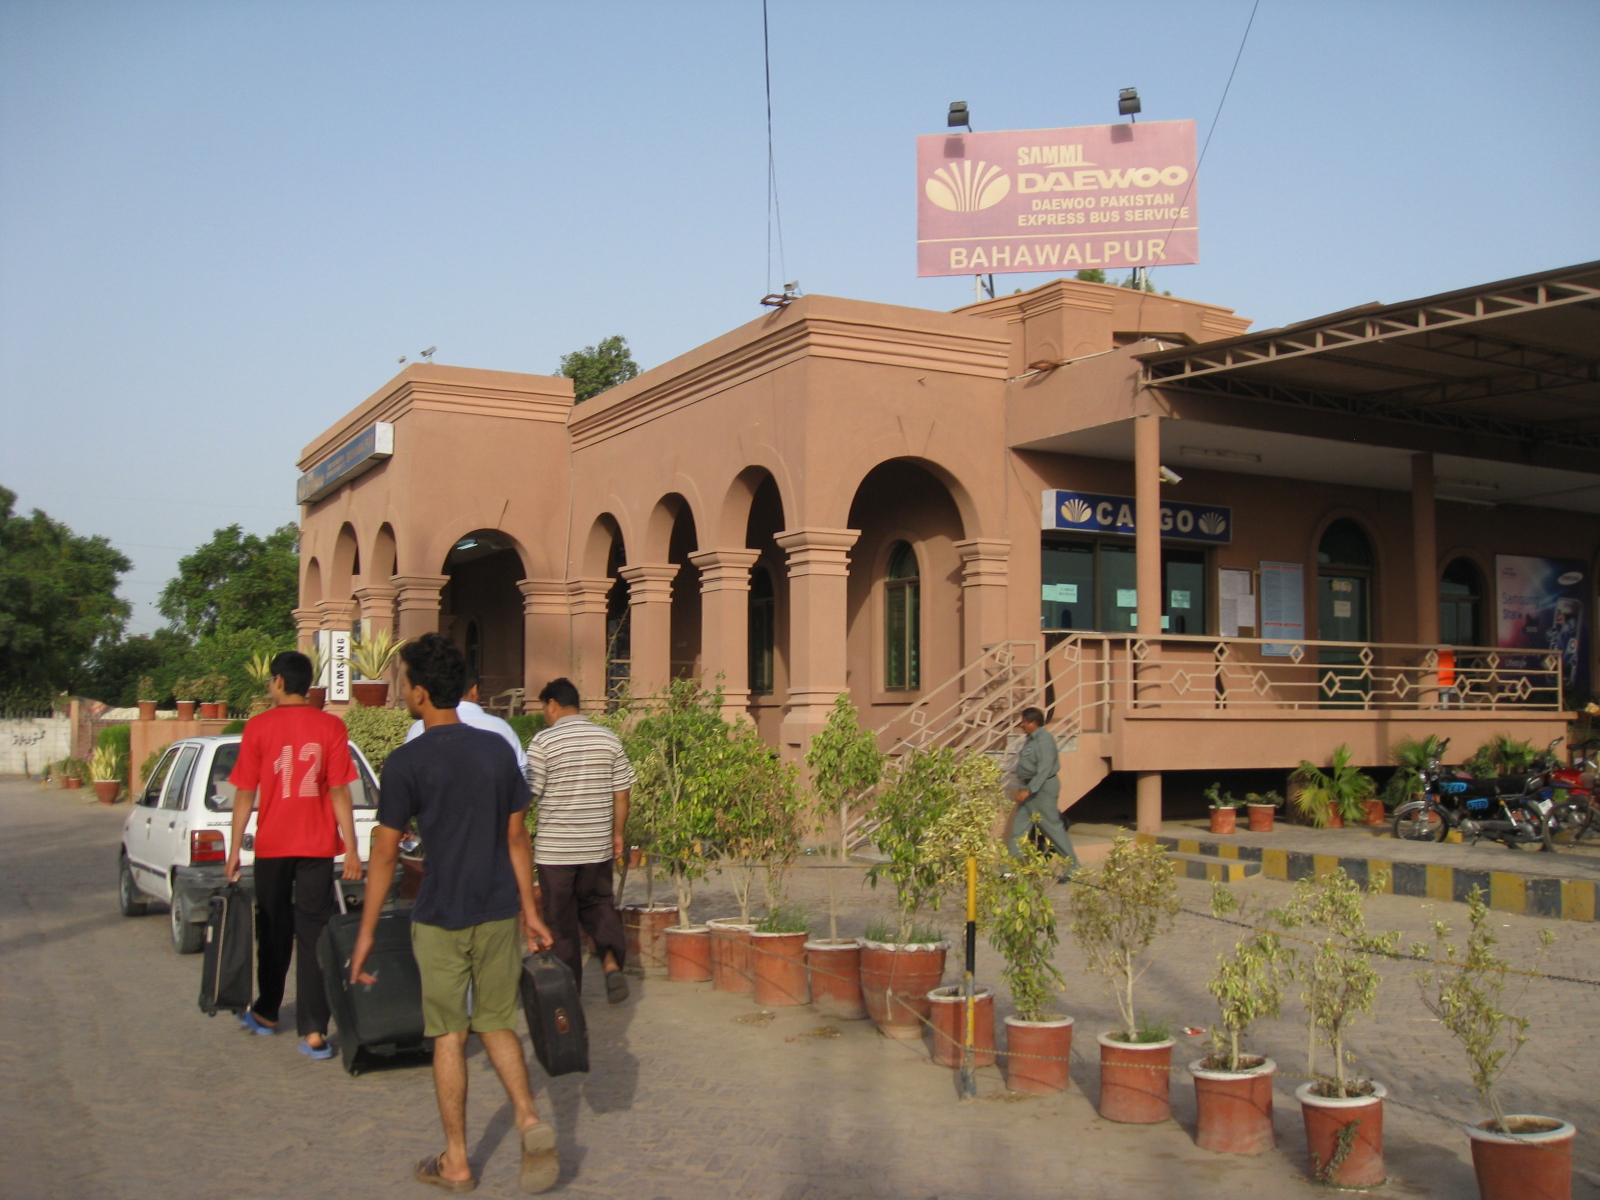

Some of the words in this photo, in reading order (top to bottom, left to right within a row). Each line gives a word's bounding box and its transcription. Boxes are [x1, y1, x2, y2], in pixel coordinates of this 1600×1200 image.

[1017, 144, 1084, 167] SAMMI
[1017, 165, 1189, 194] DAEWOO
[1018, 212, 1085, 227] EXPRESS
[1090, 209, 1120, 224] BUS
[1124, 206, 1190, 222] SERVICE
[1032, 196, 1096, 211] DAEWOO
[1101, 193, 1175, 208] PAKISTAN
[950, 238, 1167, 270] BAHAWALPUR
[1096, 502, 1194, 533] CAGO
[336, 638, 345, 694] SAMSUNG
[273, 742, 323, 799] 12
